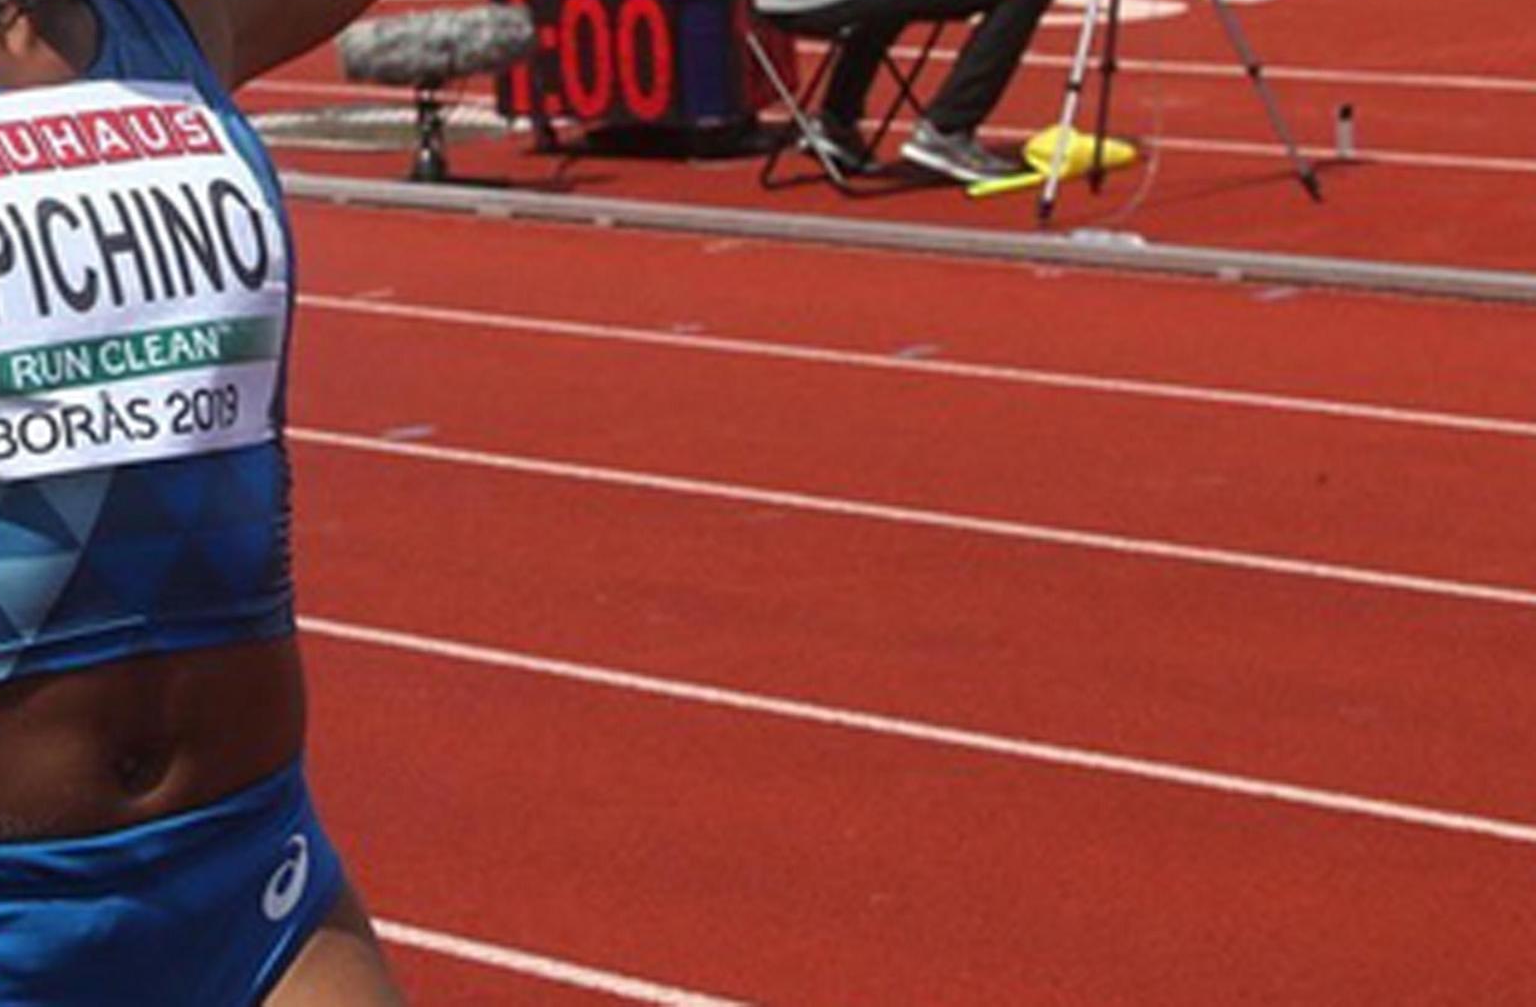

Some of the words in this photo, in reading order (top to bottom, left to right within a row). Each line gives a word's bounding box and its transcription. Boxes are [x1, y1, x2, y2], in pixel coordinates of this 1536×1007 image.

[11, 344, 92, 389] RUN
[99, 328, 222, 375] CLEAN
[166, 384, 240, 435] 2019
